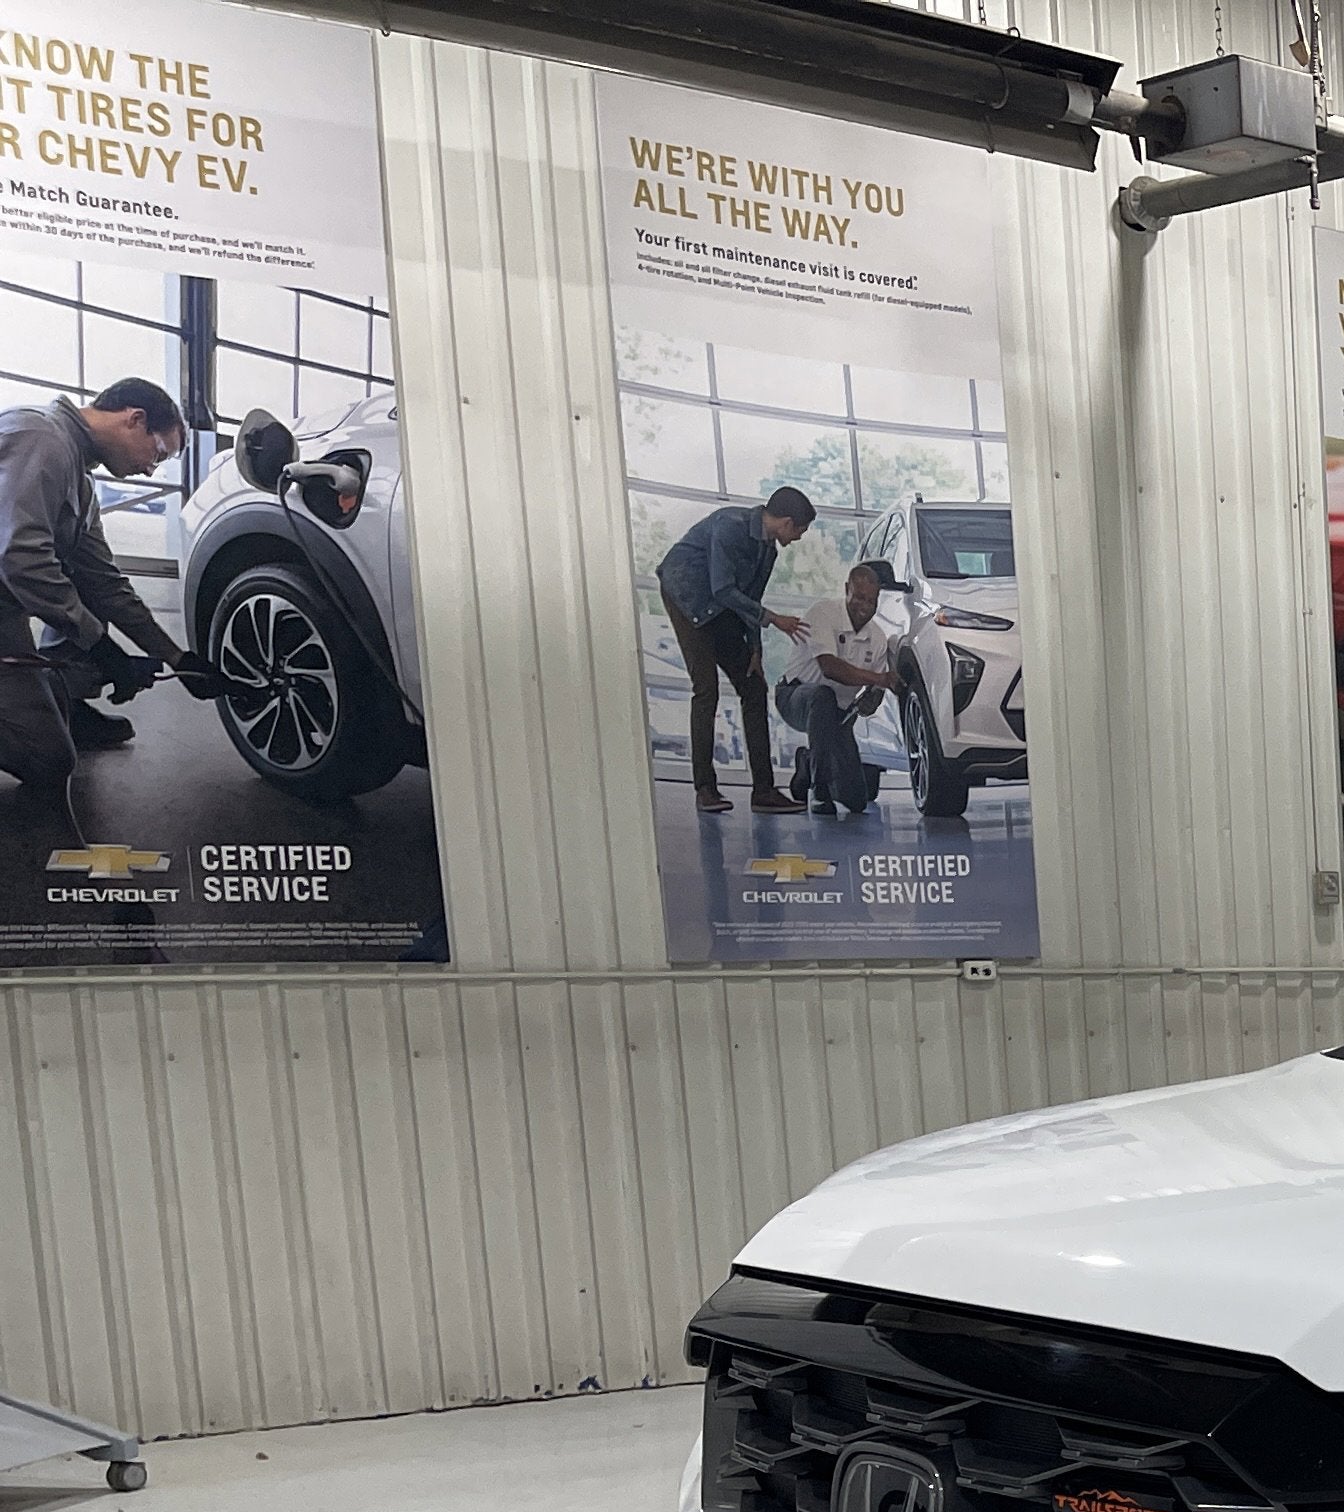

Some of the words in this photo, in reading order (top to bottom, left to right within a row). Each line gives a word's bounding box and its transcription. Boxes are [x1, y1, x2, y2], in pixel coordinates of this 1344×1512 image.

[130, 53, 212, 100] THE
[47, 84, 172, 138] TIRES
[187, 109, 264, 152] FOR
[38, 129, 183, 184] CHEVY
[197, 155, 258, 195] EV.
[629, 136, 739, 188] WE'RE
[747, 160, 834, 206] WITH
[842, 178, 905, 218] YOU
[10, 180, 69, 204] Match
[76, 190, 179, 220] Guarantee.
[633, 178, 699, 220] ALL
[707, 192, 773, 234] THE
[782, 207, 859, 249] WAY.
[635, 227, 670, 248] Your
[674, 235, 709, 256] first
[712, 246, 806, 274] maintenance
[809, 261, 840, 279] visit
[843, 266, 855, 281] is
[200, 845, 352, 871] CERTIFIED
[859, 855, 970, 877] CERTIFIED
[47, 888, 180, 903] CHEVROLET
[203, 876, 329, 902] SERVICE
[742, 891, 844, 904] CHEVROLET
[861, 882, 955, 903] SERVICE
